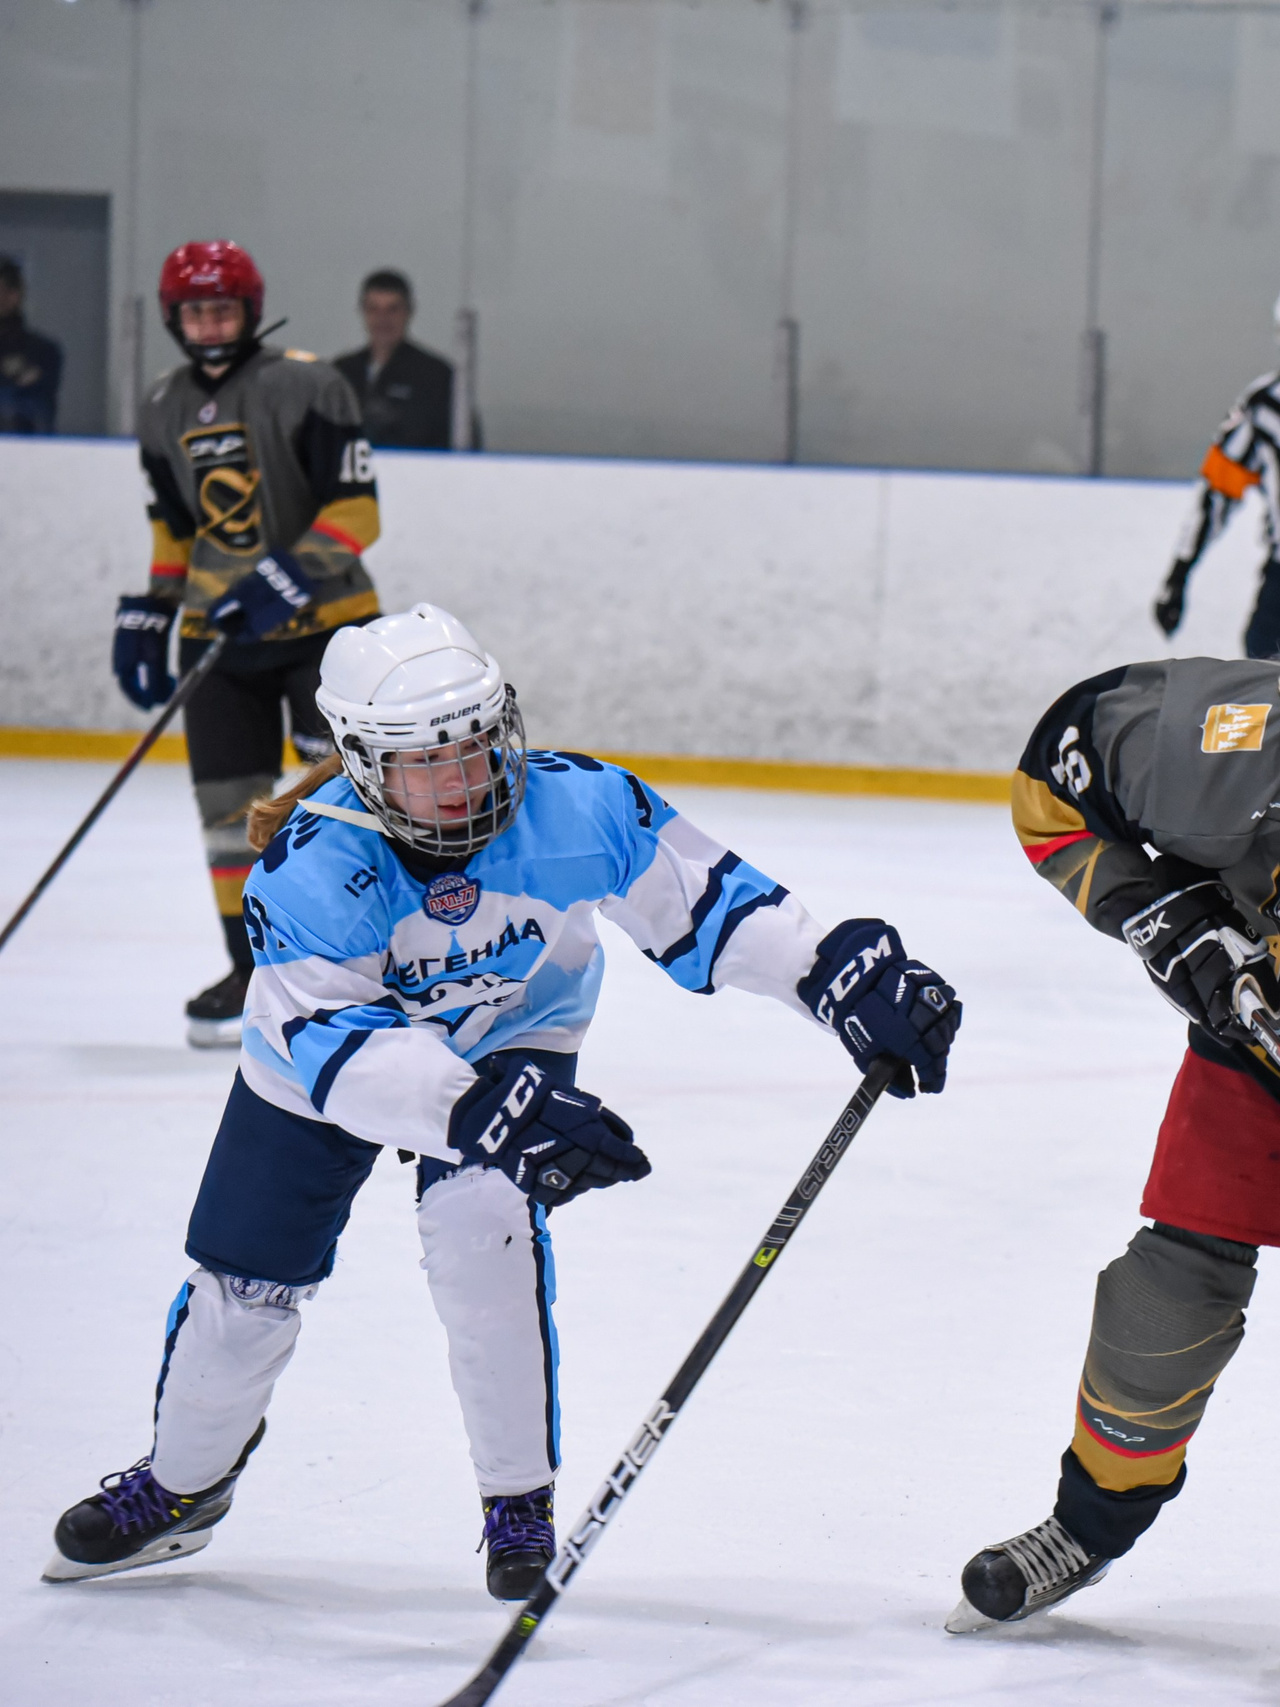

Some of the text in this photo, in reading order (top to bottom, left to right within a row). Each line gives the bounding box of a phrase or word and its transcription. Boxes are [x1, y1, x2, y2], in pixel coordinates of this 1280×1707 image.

[429, 702, 482, 728] BAUER
[382, 918, 547, 987] ЛЕГЕНДА
[816, 933, 893, 1028] CCM
[545, 1398, 678, 1596] FISCHER
